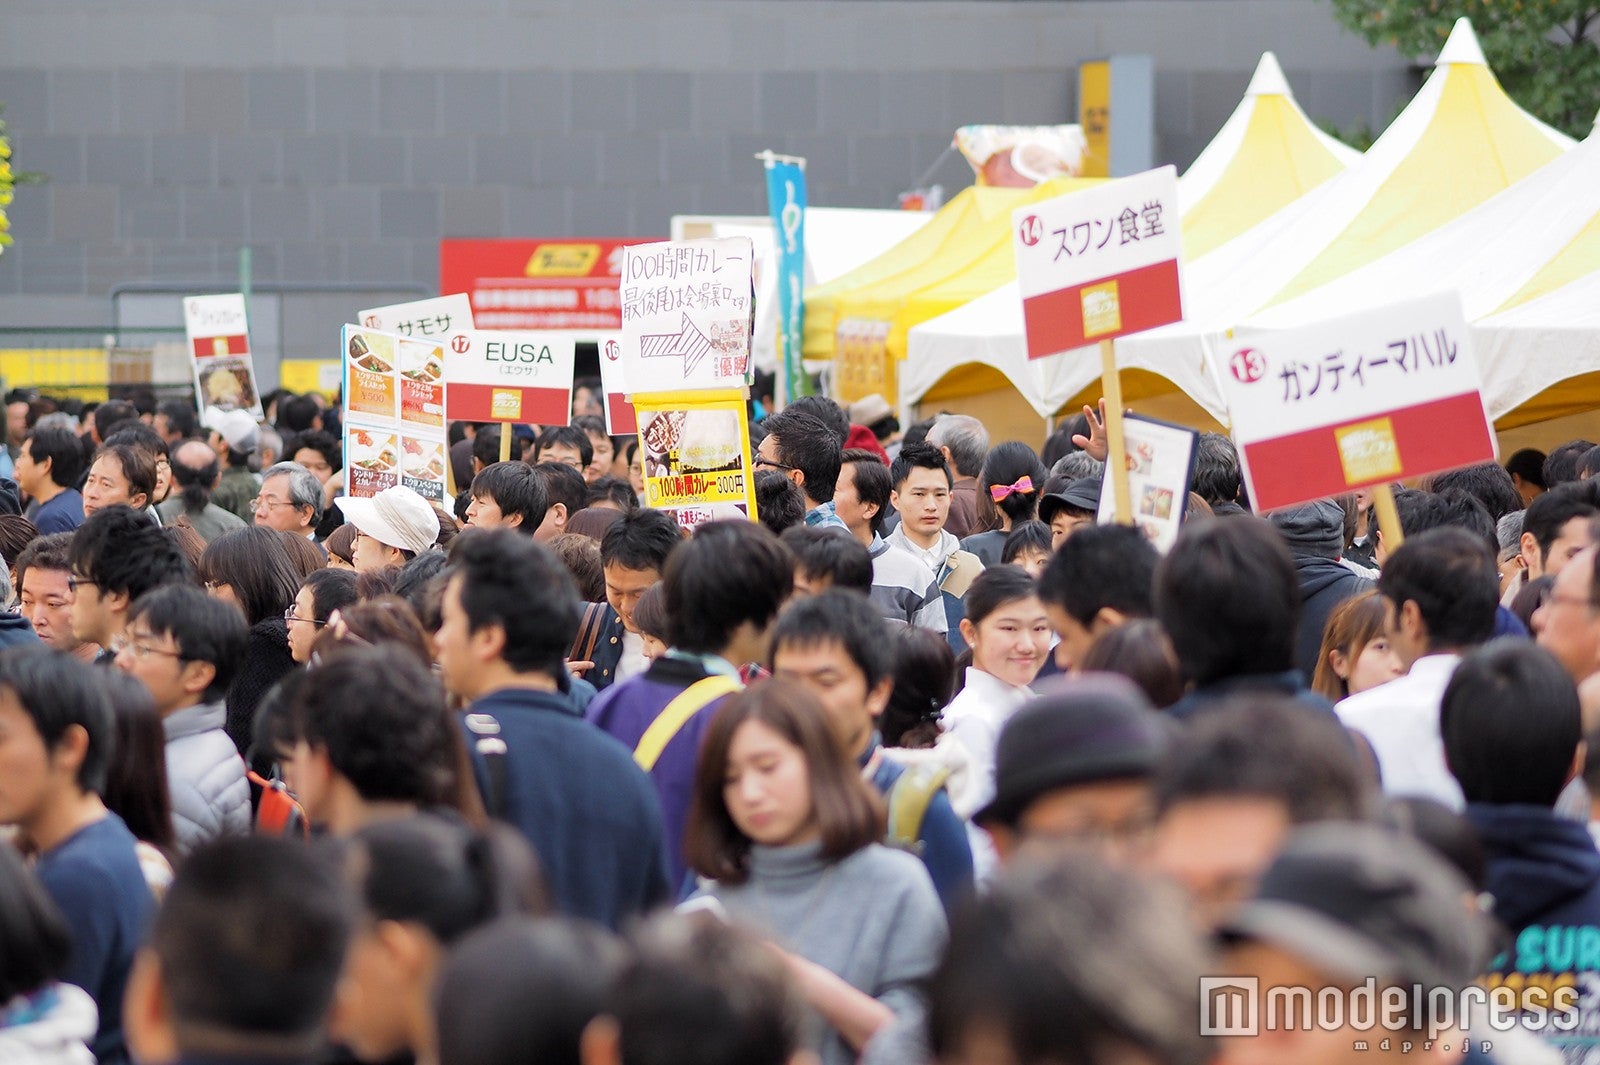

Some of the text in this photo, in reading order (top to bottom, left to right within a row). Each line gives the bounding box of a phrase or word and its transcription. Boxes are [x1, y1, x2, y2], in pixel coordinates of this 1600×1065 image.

[1052, 199, 1165, 262] スワン食堂
[626, 247, 743, 284] 100時間カレー
[397, 313, 453, 337] サモサ
[452, 335, 470, 353] 17
[486, 342, 554, 364] EUSA
[606, 341, 620, 360] 16
[1230, 348, 1267, 383] 13
[1280, 327, 1458, 402] ガンディーマハル
[659, 474, 717, 498] 100時間カレー
[717, 474, 744, 495] 300円
